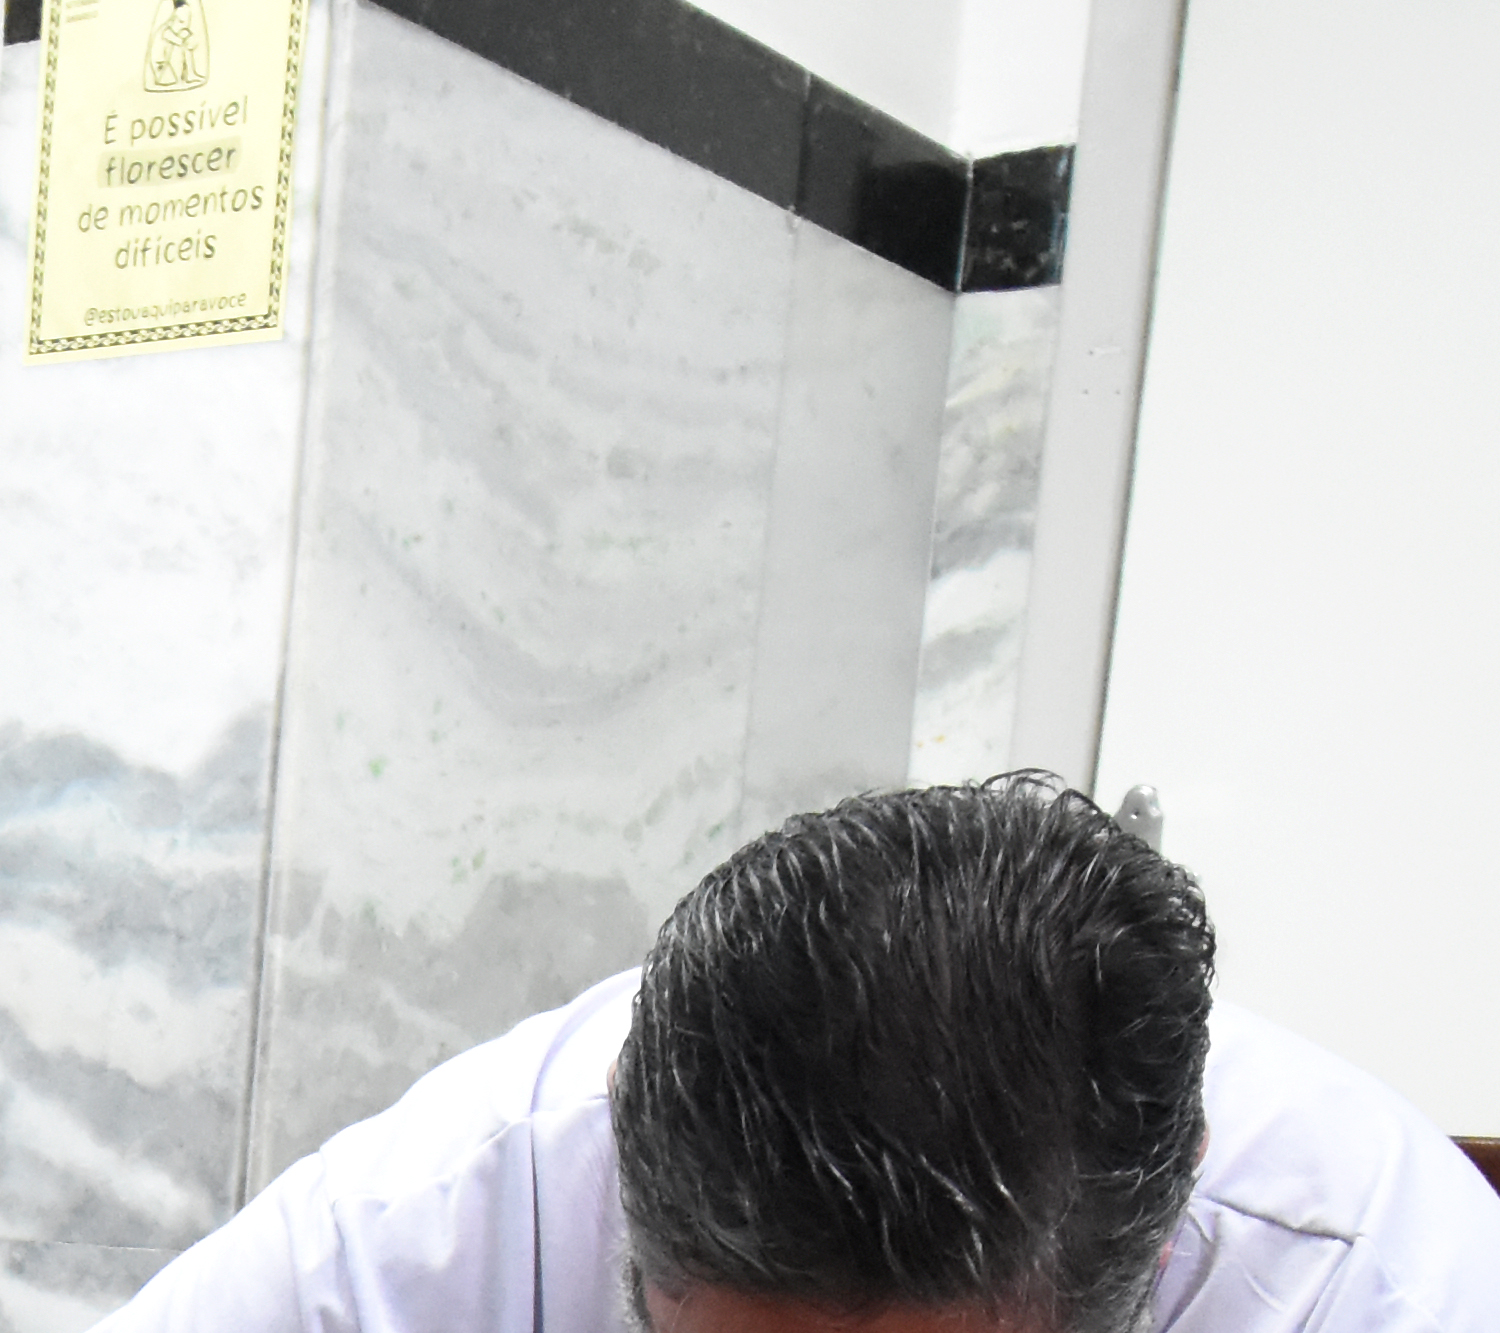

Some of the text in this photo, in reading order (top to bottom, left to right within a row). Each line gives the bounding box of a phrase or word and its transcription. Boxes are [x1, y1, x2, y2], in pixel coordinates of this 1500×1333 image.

[104, 95, 249, 147] É possível
[105, 146, 236, 186] florescer
[78, 184, 265, 233] de momentos
